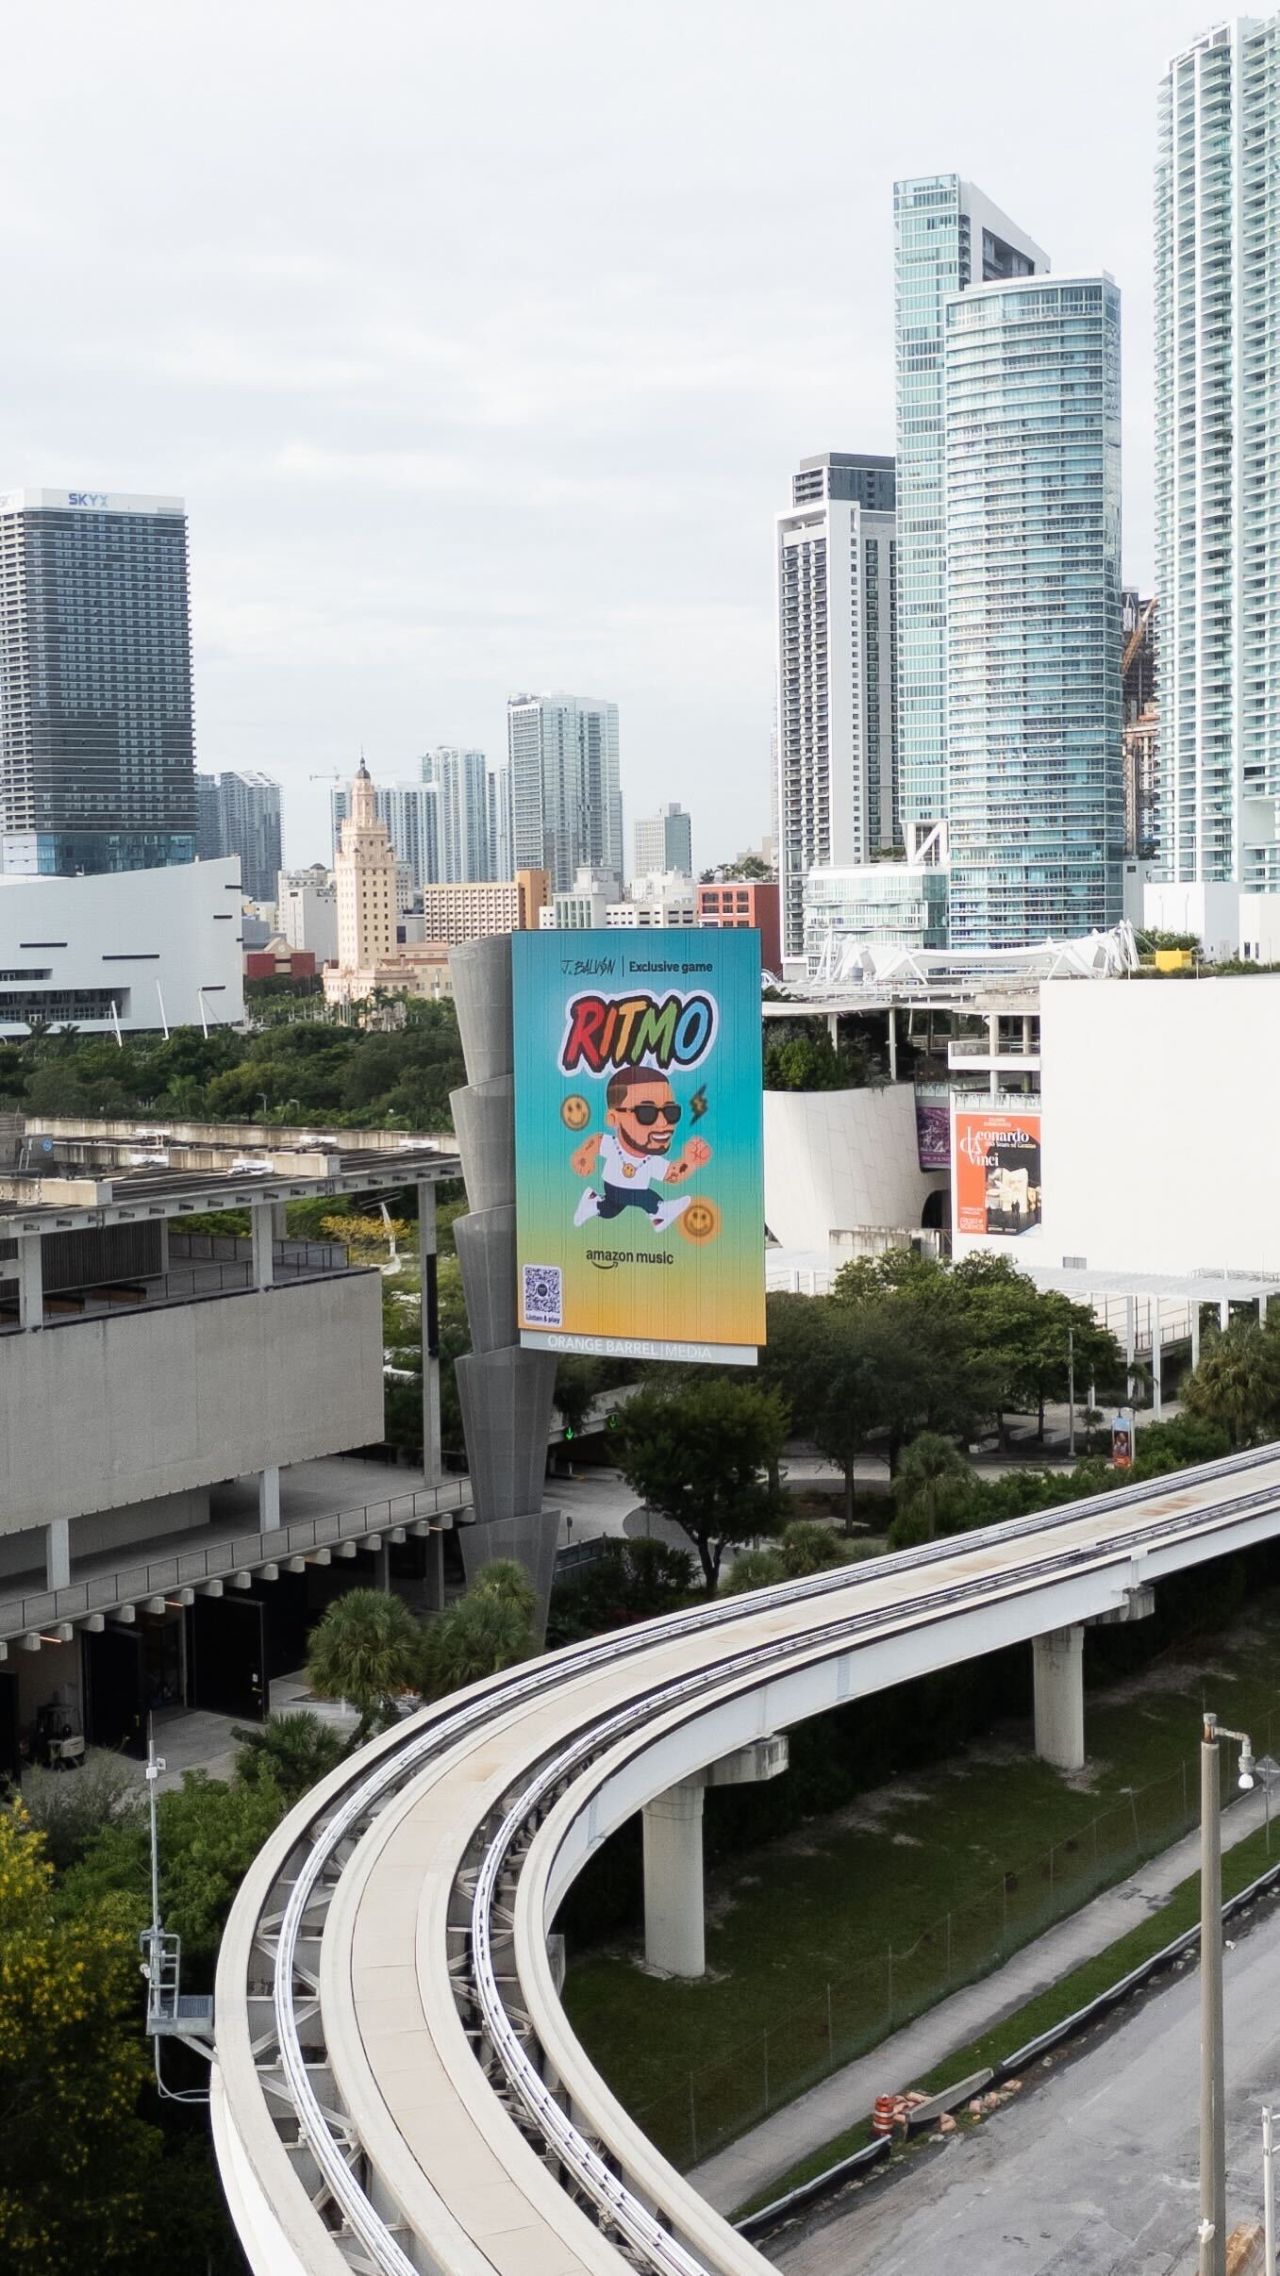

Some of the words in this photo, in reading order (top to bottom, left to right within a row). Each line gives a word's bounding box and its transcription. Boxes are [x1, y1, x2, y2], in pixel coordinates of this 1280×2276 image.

[68, 493, 109, 508] SKYX
[629, 961, 680, 973] Exclusive
[681, 964, 713, 974] game
[562, 995, 714, 1073] RITMO
[967, 1126, 1030, 1143] Leonardo
[586, 1249, 634, 1262] amazon
[636, 1250, 674, 1264] music
[548, 1335, 602, 1350] ORANGE
[606, 1340, 658, 1356] BARREL
[664, 1345, 712, 1359] MEDIA
